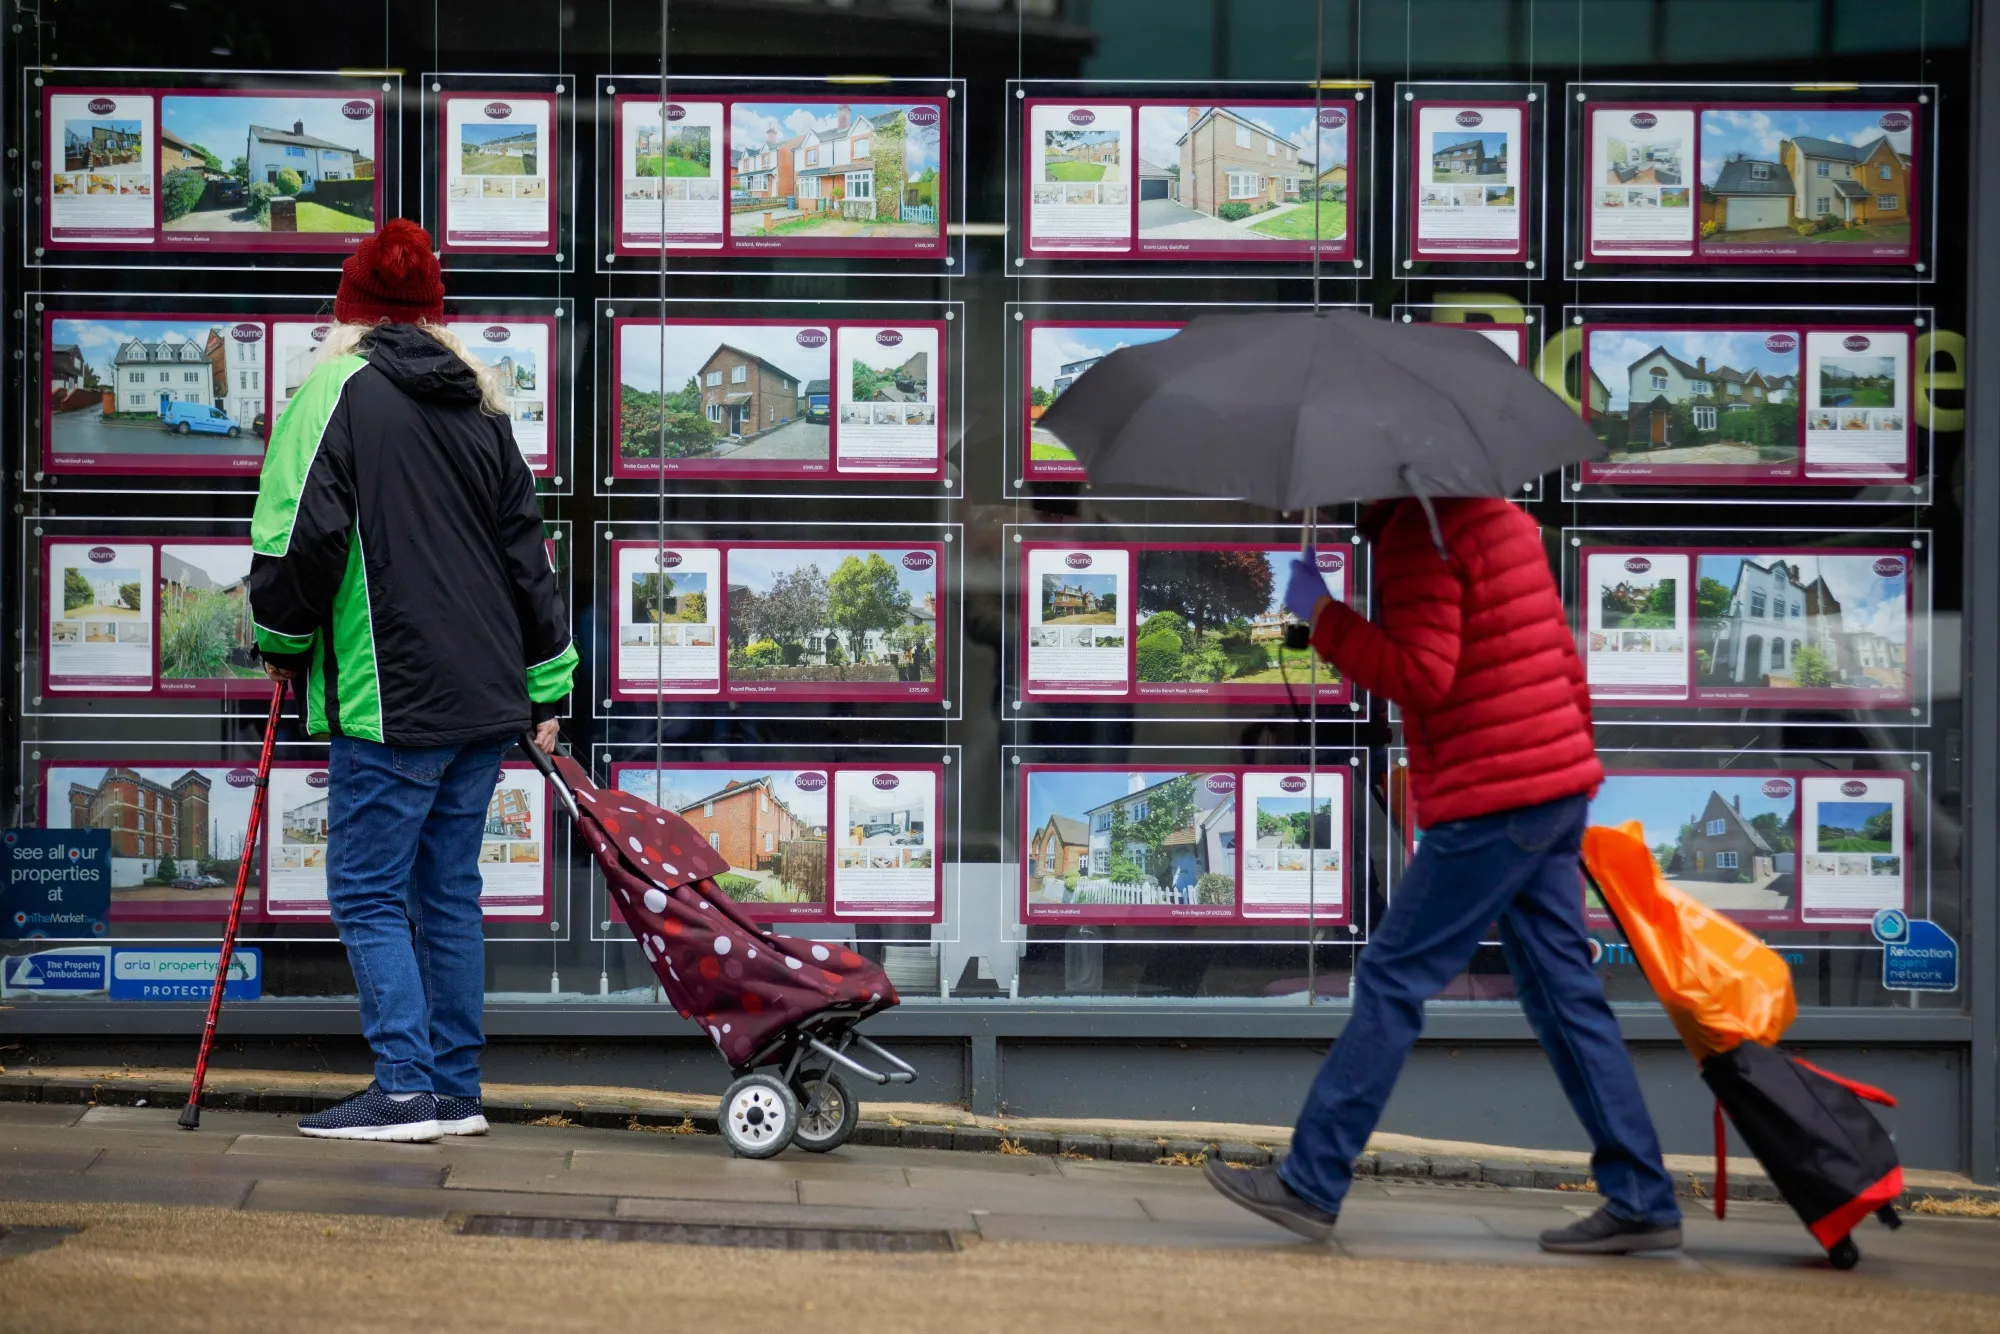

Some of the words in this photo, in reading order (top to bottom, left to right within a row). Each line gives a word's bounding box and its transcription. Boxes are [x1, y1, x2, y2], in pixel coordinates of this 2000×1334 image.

[90, 102, 116, 111] Bourne
[343, 105, 373, 115] Bourne
[484, 105, 511, 114] Bourne
[909, 111, 938, 121] Bourne
[1069, 112, 1095, 121] Bourne
[1456, 115, 1482, 124] Bourne
[1631, 117, 1657, 125] Bourne
[1880, 118, 1909, 127] Bourne
[232, 329, 263, 338] Bourne
[484, 330, 510, 338] Bourne
[797, 333, 827, 343] Bourne
[877, 333, 903, 342] Bourne
[1766, 339, 1796, 348] Bourne
[1844, 339, 1870, 347] Bourne
[89, 551, 115, 559] Bourne
[903, 556, 933, 566] Bourne
[1066, 556, 1092, 565] Bourne
[1625, 561, 1651, 569] Bourne
[1873, 562, 1904, 571] Bourne
[227, 774, 256, 783] Bourne
[796, 777, 826, 786] Bourne
[873, 776, 899, 785] Bourne
[1207, 780, 1235, 789] Bourne
[1280, 780, 1306, 788] Bourne
[1762, 784, 1792, 794] Bourne
[1841, 785, 1868, 793] Bourne
[13, 848, 43, 859] see
[48, 844, 65, 859] all
[68, 847, 98, 862] our
[11, 865, 100, 885] properties
[47, 886, 63, 901] at
[1889, 946, 1953, 959] Relocation
[47, 960, 62, 969] The
[64, 960, 101, 971] Property
[124, 960, 151, 970] arla
[158, 960, 247, 973] propertyark
[1889, 959, 1928, 969] agent
[46, 970, 100, 979] Ombudsman
[1889, 969, 1942, 979] network
